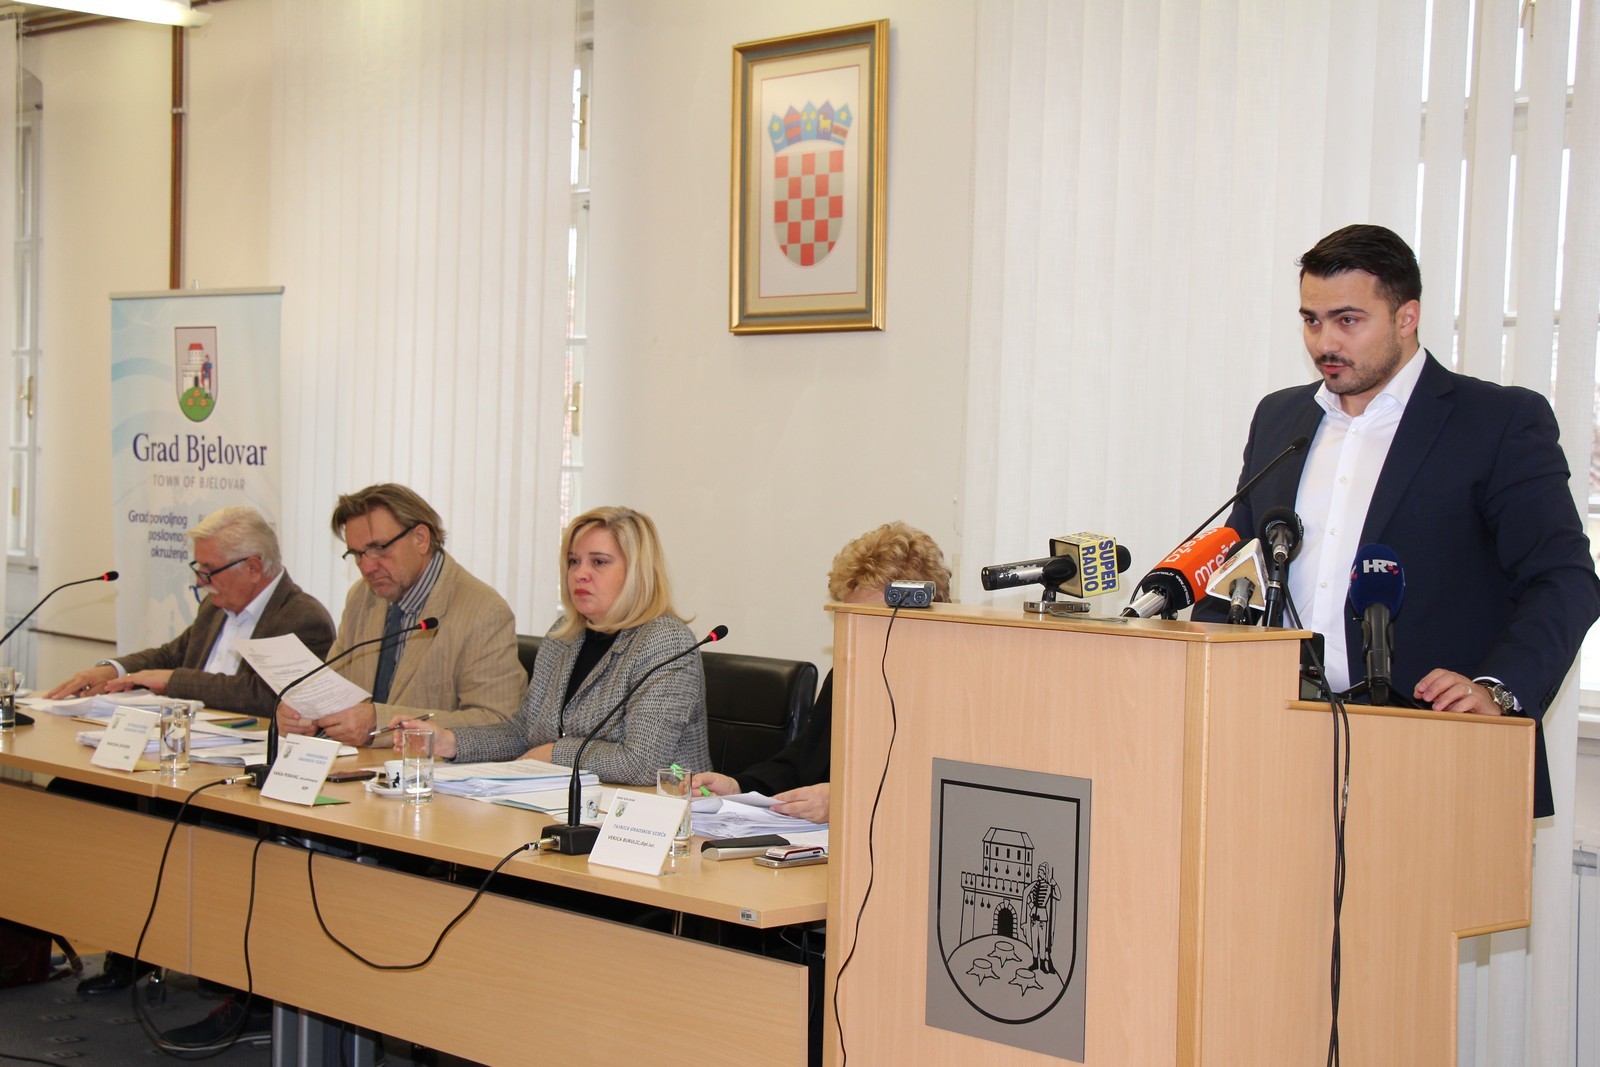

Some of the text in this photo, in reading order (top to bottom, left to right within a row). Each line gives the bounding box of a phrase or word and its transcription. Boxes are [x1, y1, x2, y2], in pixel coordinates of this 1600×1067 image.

[132, 432, 267, 472] Grad Bjelovar
[153, 474, 246, 491] TOWN OF BJELOVAR
[1081, 545, 1099, 592] RADIO
[1099, 540, 1117, 591] SUPER
[1362, 558, 1399, 575] HRT
